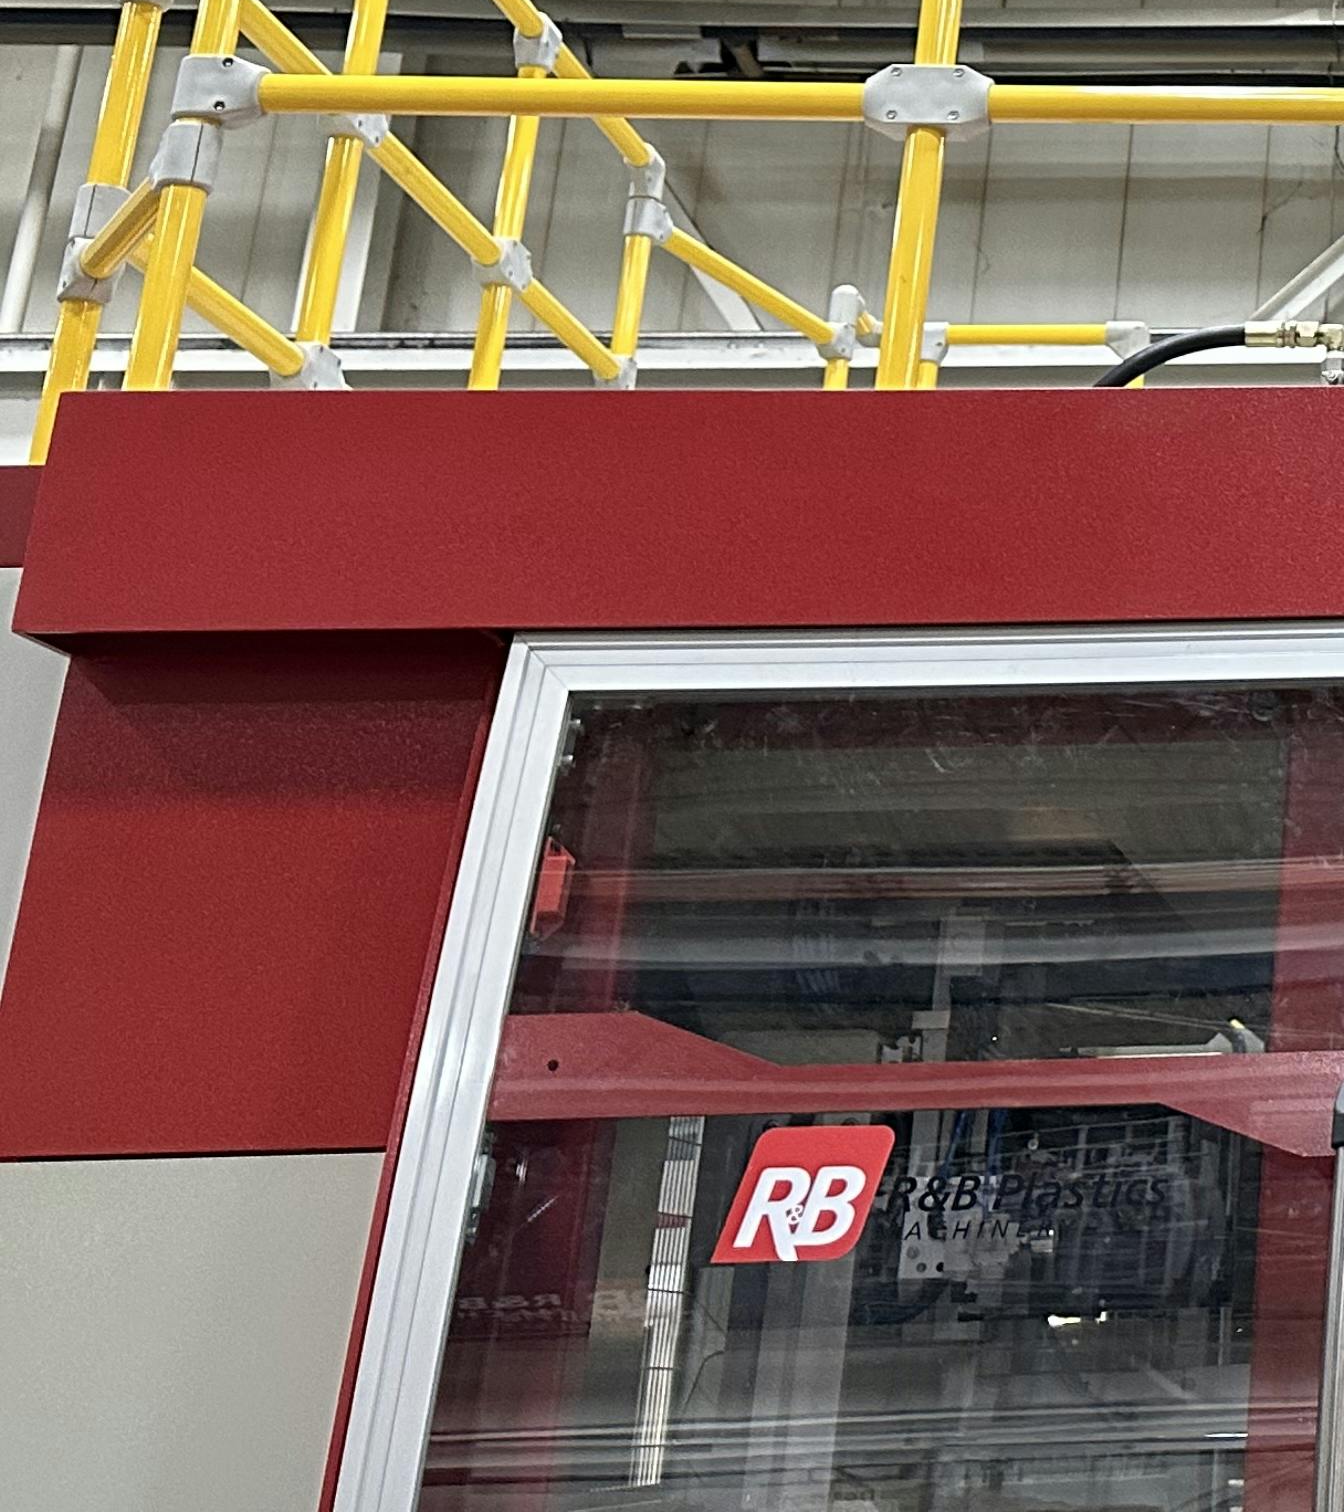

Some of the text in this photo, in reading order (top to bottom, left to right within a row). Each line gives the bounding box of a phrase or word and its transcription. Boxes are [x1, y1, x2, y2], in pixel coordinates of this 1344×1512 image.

[888, 1172, 1168, 1212] R&B Plastics
[896, 1220, 1058, 1241] ACHINER
